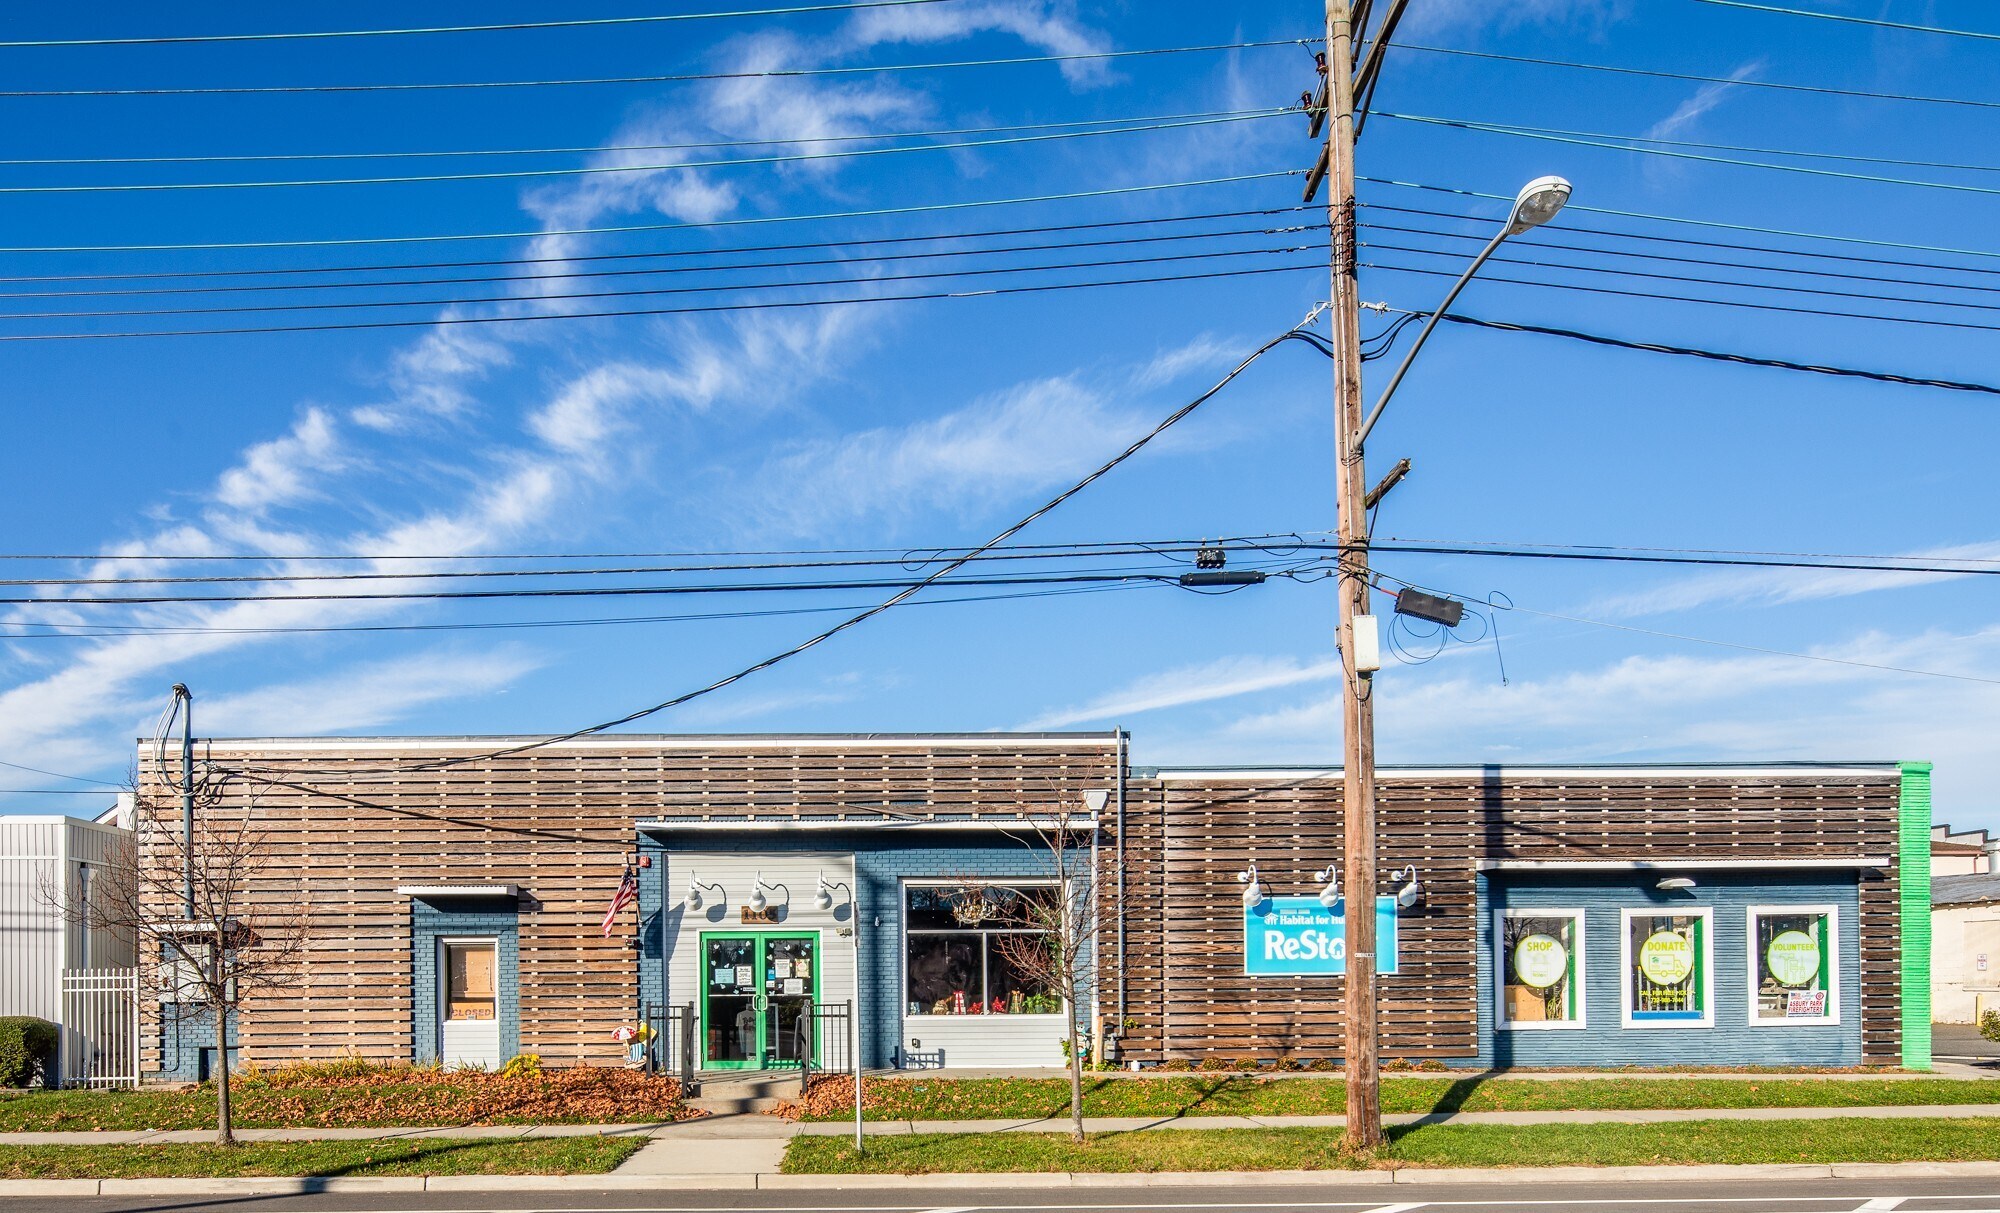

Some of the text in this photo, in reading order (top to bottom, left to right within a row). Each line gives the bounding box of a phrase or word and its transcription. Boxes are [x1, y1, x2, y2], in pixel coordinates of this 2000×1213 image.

[1280, 915, 1314, 925] Habitat
[1315, 915, 1329, 925] for
[1264, 929, 1346, 960] ReSto
[451, 1008, 491, 1017] CLOSED
